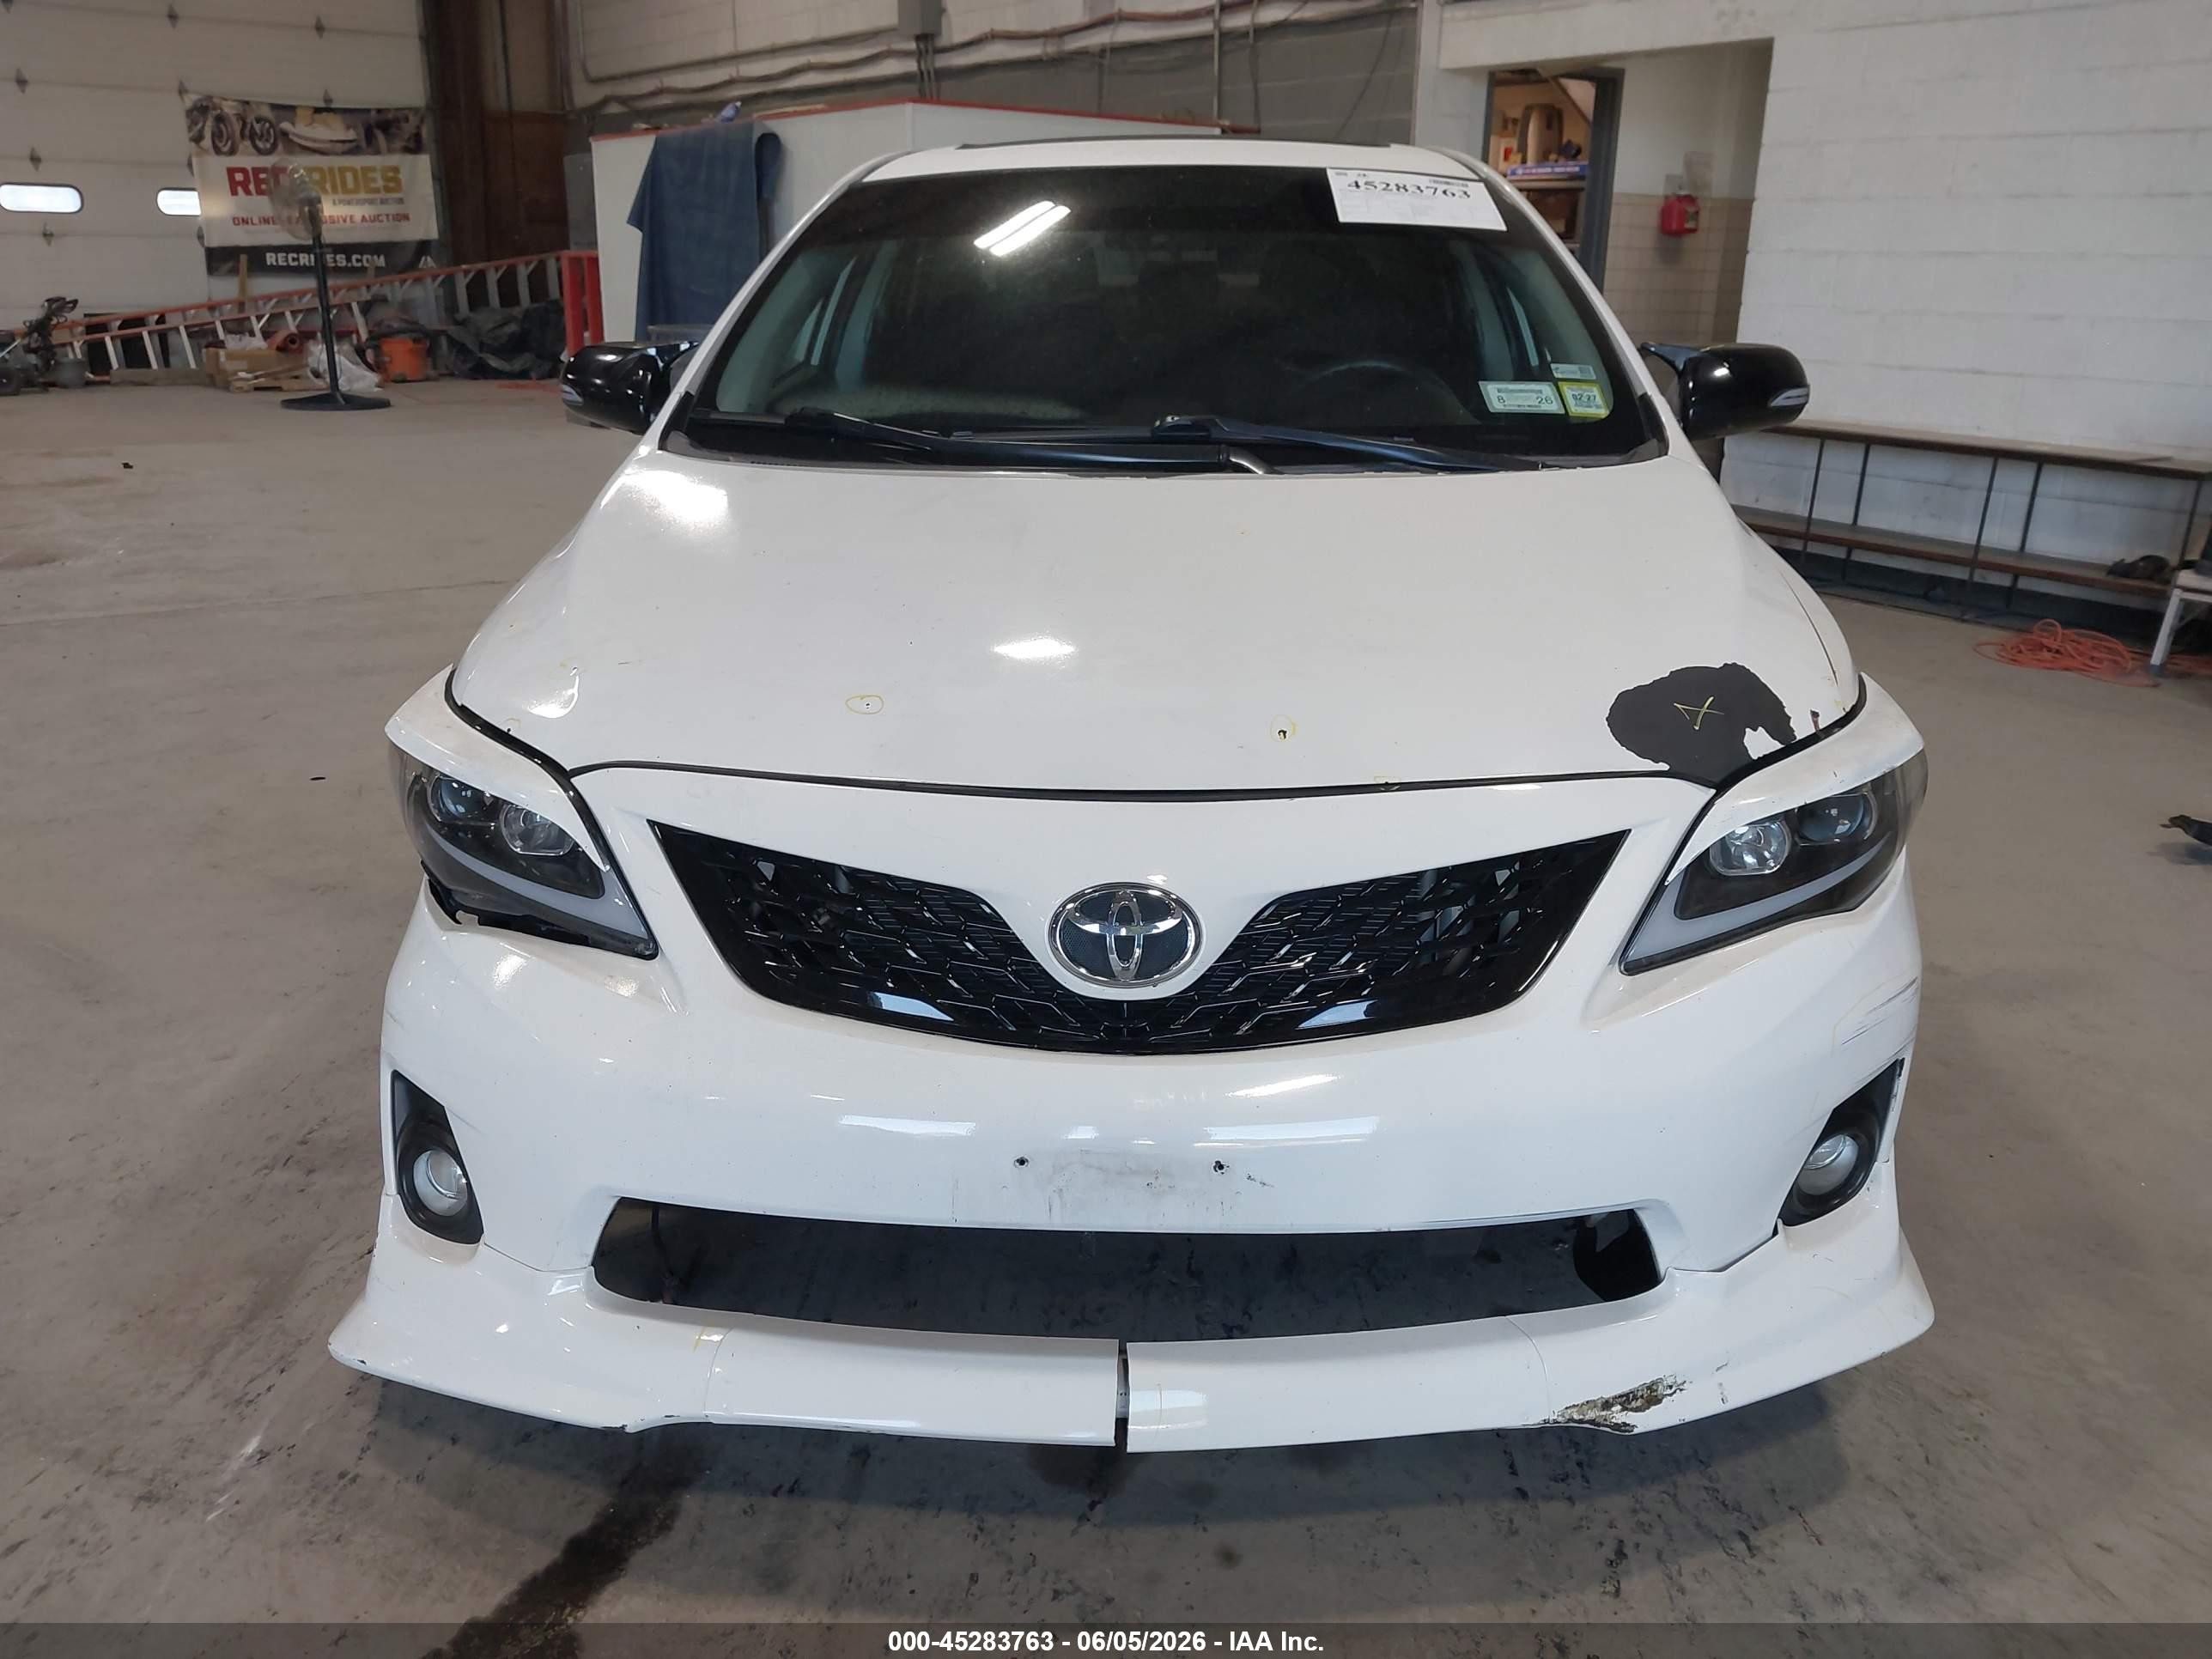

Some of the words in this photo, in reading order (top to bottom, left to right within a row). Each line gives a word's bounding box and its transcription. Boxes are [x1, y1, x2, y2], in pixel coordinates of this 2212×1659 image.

[1346, 179, 1471, 199] 45283763
[361, 213, 410, 224] AUCTION
[265, 252, 386, 268] RECRIES.COM
